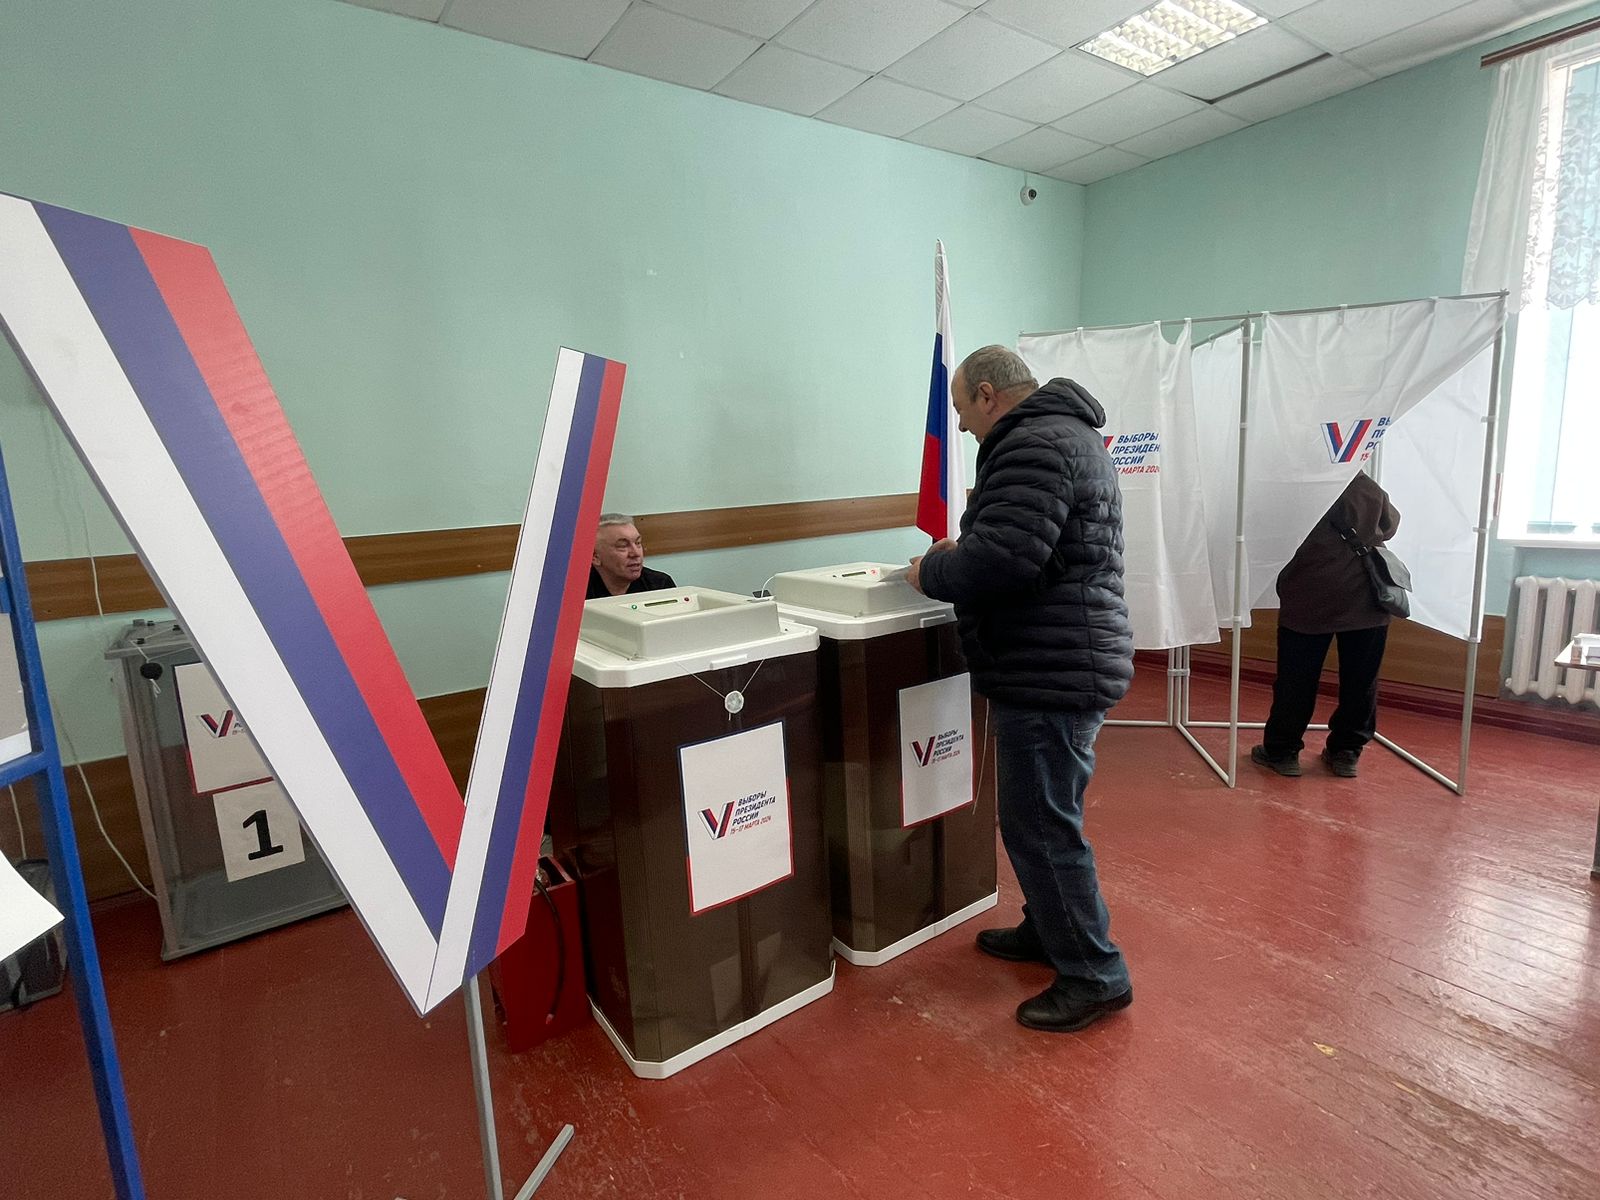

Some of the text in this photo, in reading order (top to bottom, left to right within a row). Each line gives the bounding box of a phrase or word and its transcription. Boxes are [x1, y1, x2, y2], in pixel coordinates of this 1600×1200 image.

[1117, 432, 1159, 443] ВЫБОРЫ
[1111, 444, 1160, 455] ПРЕЗИДЕН
[1111, 455, 1145, 465] ОССИИ
[1120, 466, 1145, 475] МАРТА
[737, 790, 767, 806] ВЫБОРЫ
[734, 796, 776, 817] ПРЕЗИДЕНТА
[731, 811, 759, 826] РОССИИ
[242, 809, 284, 861] 1
